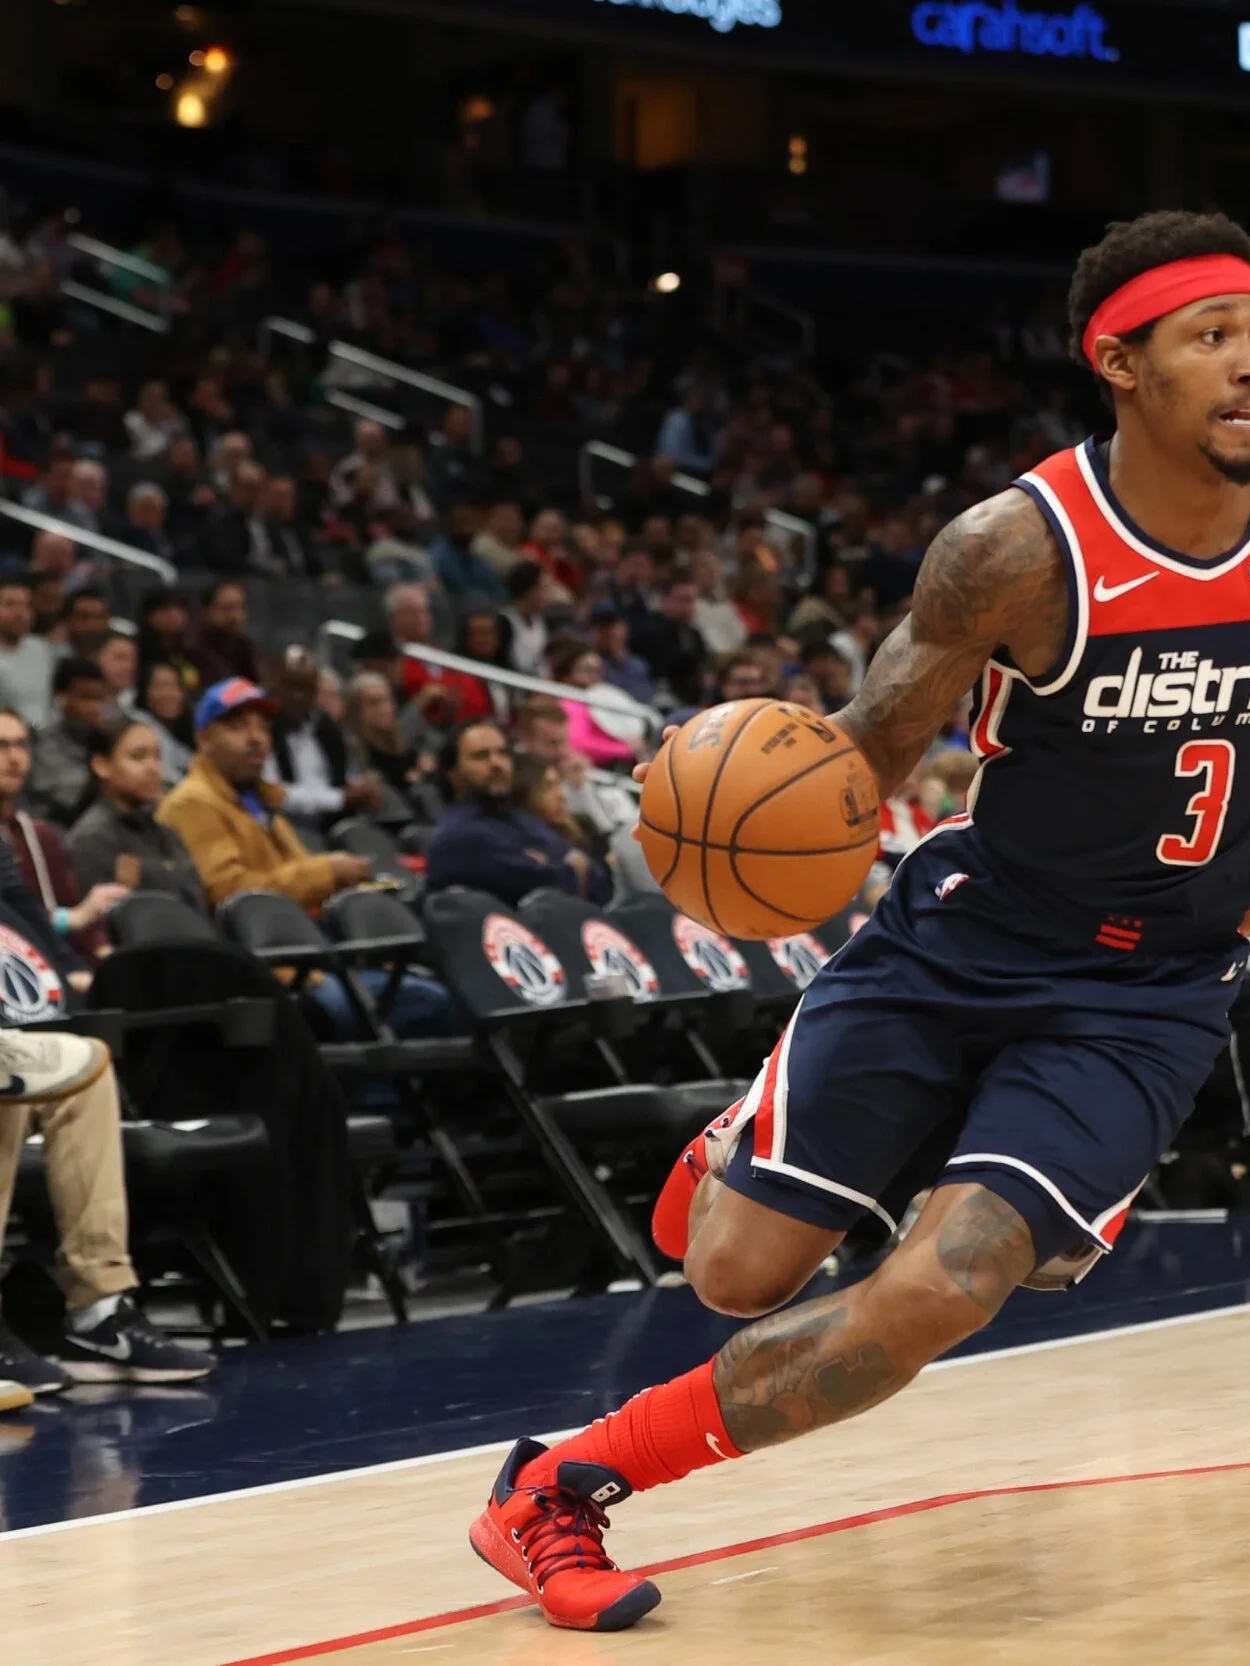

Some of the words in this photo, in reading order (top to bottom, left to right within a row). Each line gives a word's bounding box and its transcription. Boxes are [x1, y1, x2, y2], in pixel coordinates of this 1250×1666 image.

[1158, 651, 1199, 670] THE
[1081, 719, 1119, 734] OF
[1156, 738, 1235, 867] 3
